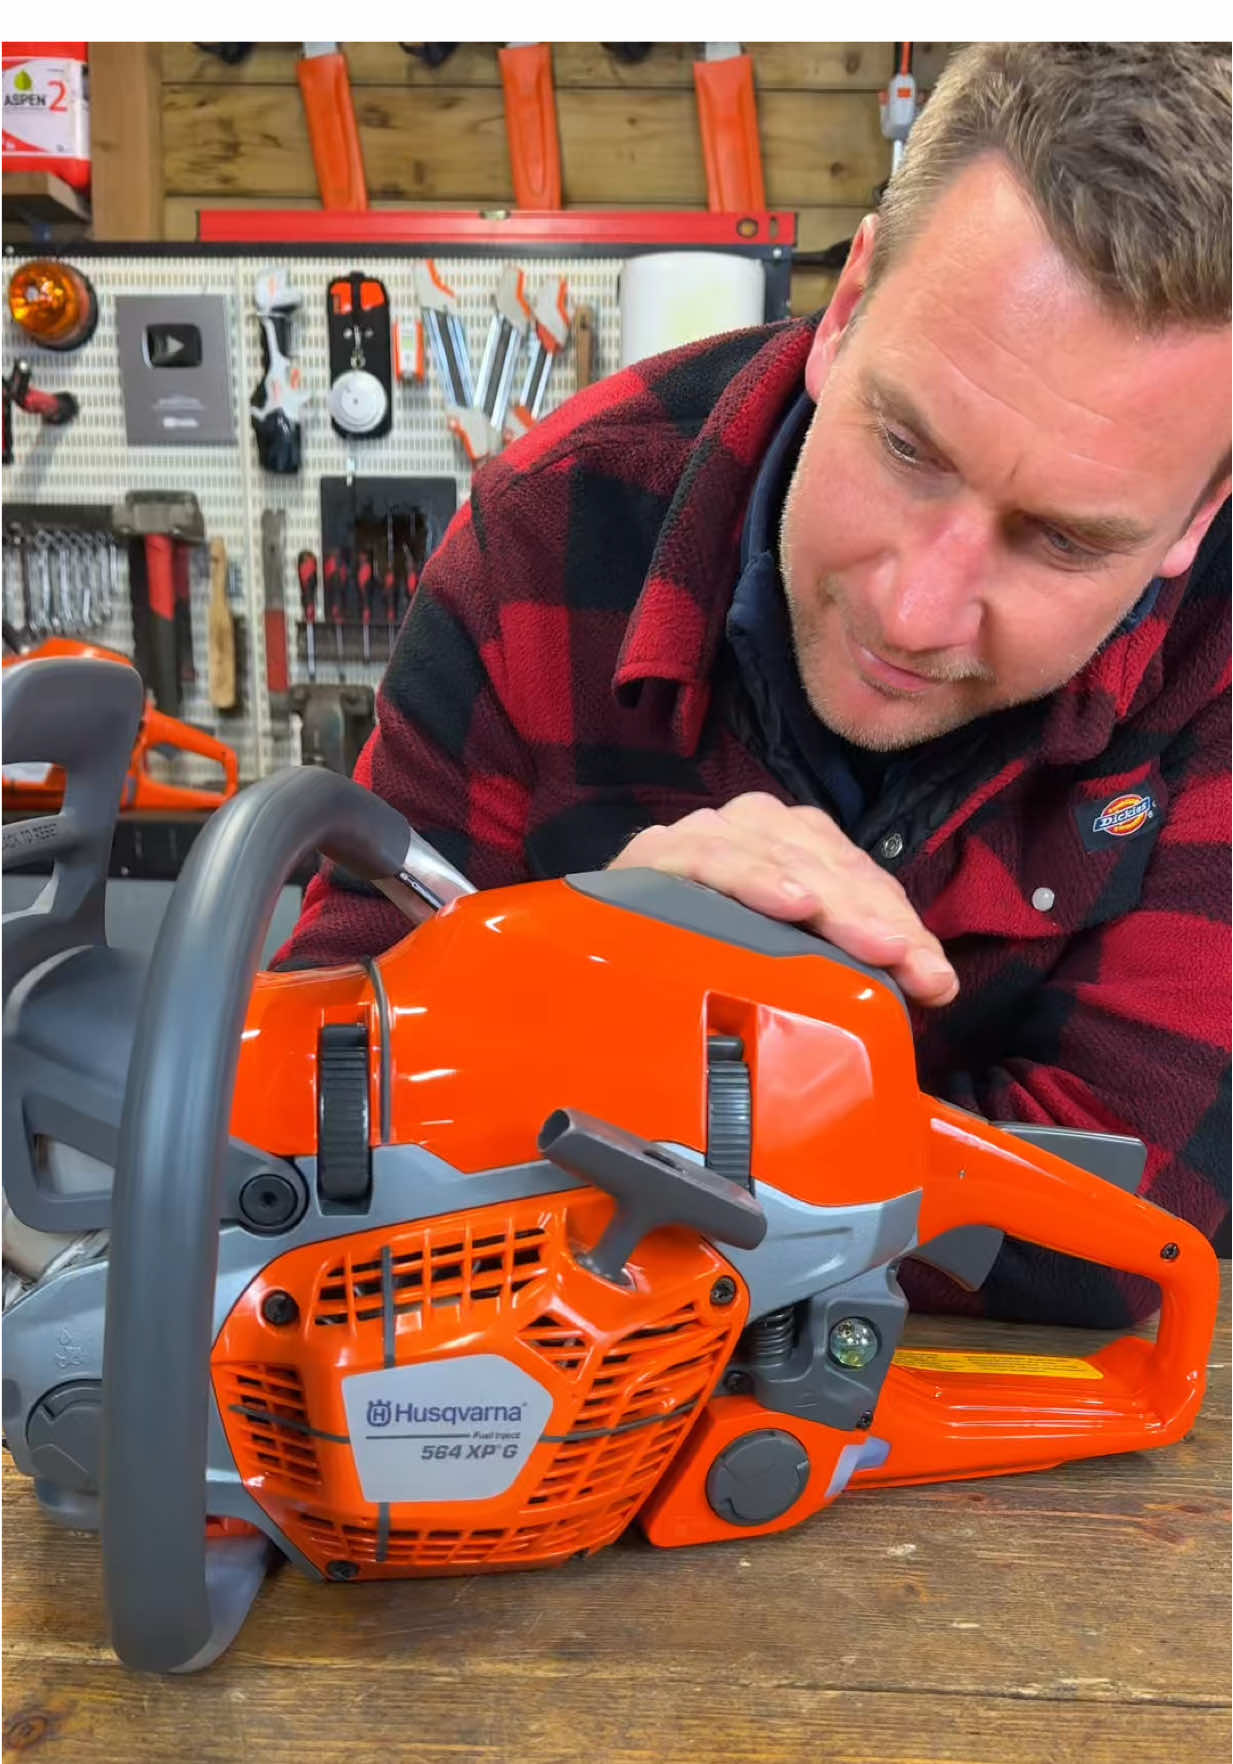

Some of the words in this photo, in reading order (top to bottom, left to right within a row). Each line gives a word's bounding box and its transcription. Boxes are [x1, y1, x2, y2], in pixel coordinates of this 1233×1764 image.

[4, 93, 46, 106] ASPEN
[47, 80, 68, 112] 2
[1100, 803, 1147, 826] Dickies
[395, 1403, 521, 1425] Husqvarna
[421, 1445, 461, 1460] 564
[502, 1444, 519, 1459] G
